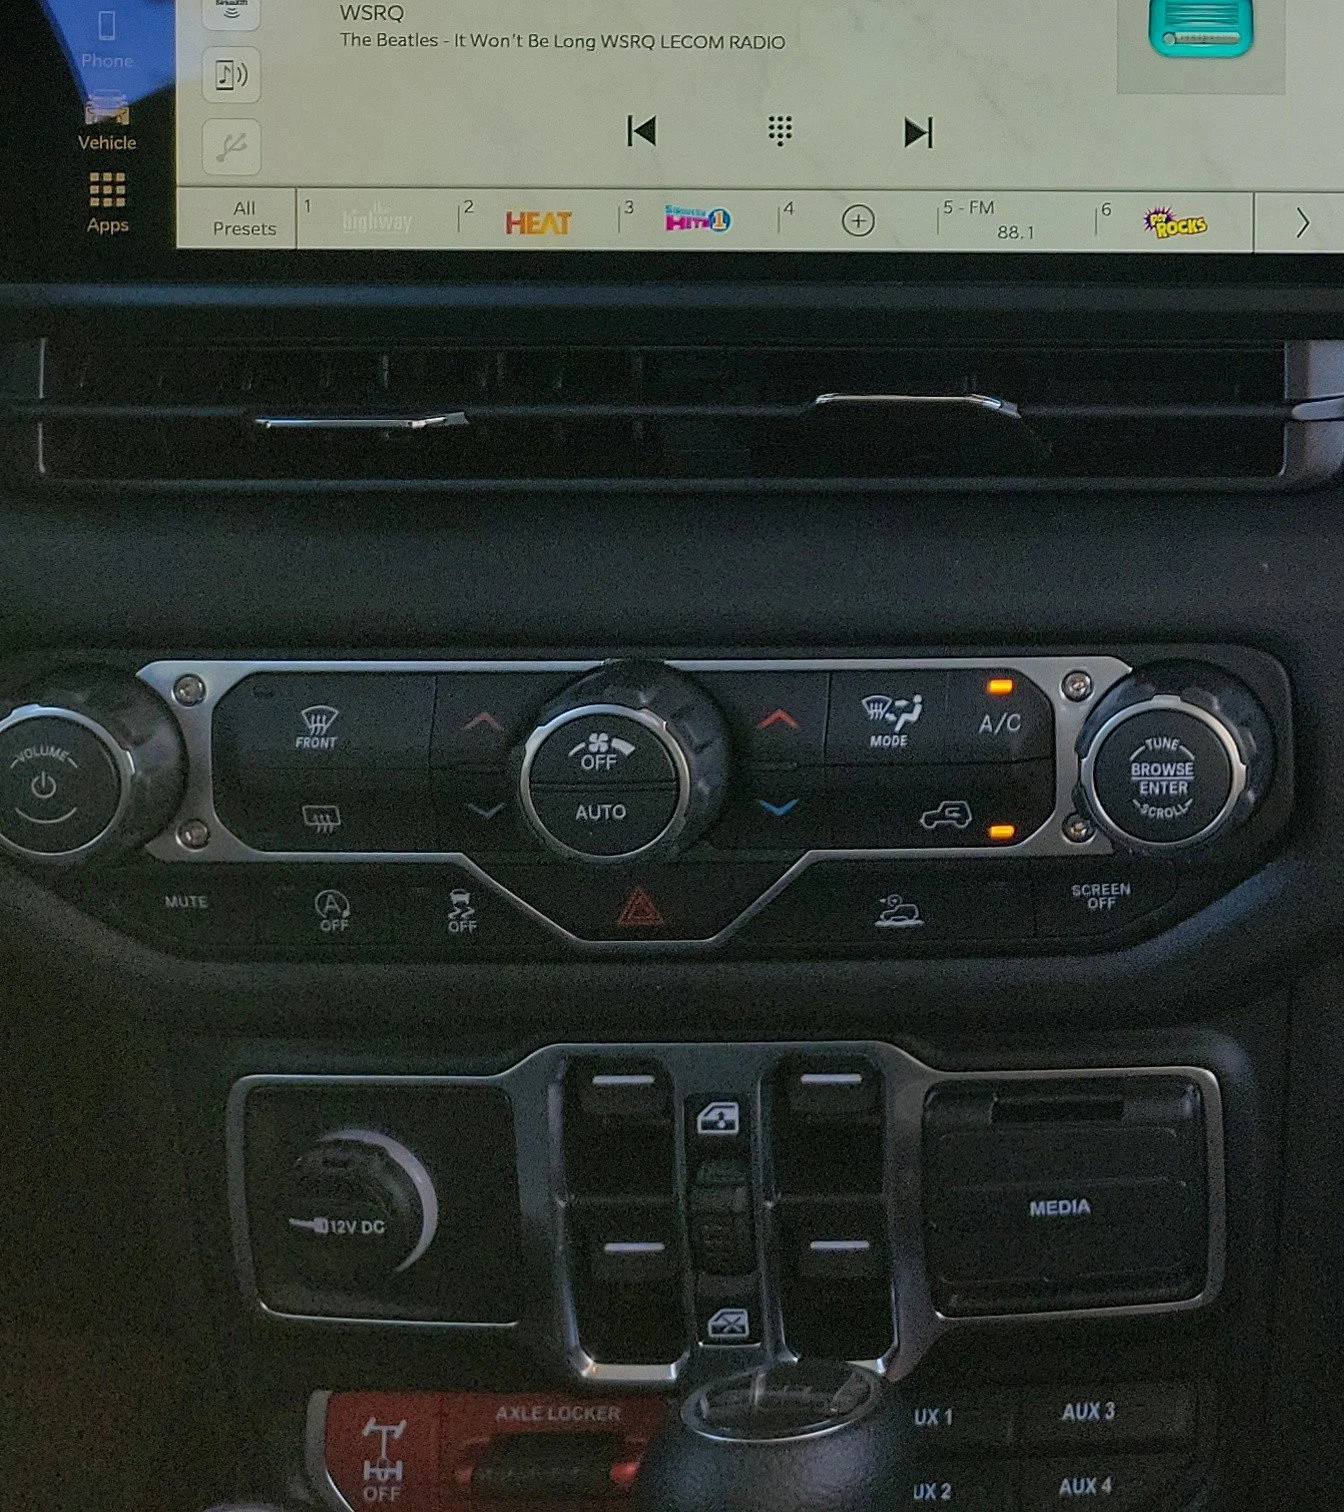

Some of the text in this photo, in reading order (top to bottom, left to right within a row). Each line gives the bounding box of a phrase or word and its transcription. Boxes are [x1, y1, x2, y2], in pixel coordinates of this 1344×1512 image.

[339, 4, 405, 23] WSRQ
[340, 32, 372, 47] The
[377, 33, 439, 48] Beatles
[454, 33, 466, 48] It
[469, 33, 524, 48] Won't
[528, 34, 550, 48] Be
[554, 35, 596, 52] Long
[601, 34, 656, 50] WSRQ
[660, 35, 724, 50] LECOM
[729, 35, 786, 50] RADIO
[82, 53, 133, 69] Phone
[78, 135, 137, 150] Vehicle
[233, 200, 255, 216] All
[304, 198, 311, 213] 1
[464, 199, 475, 214] 2
[624, 200, 634, 214] 3
[783, 201, 794, 215] 4
[943, 200, 953, 214] 5
[969, 200, 995, 215] FM
[1101, 202, 1112, 217] 6
[87, 218, 129, 235] Apps
[213, 221, 277, 236] Presets
[505, 210, 573, 235] HEAT
[1155, 217, 1208, 239] ROCKS
[997, 225, 1034, 240] 88.1
[979, 713, 1021, 735] A/C
[295, 736, 337, 749] FRONT
[870, 735, 907, 748] MODE
[1145, 737, 1180, 751] TUNE
[15, 744, 71, 762] VOLUME
[580, 754, 617, 771] OFF
[1131, 762, 1194, 776] BROWSE
[1140, 781, 1188, 795] ENTER
[575, 804, 626, 821] AUTO
[1140, 803, 1188, 819] SCROLL
[1071, 883, 1131, 897] SCREEN
[165, 895, 209, 909] MUTE
[1087, 897, 1116, 910] OFF
[320, 919, 349, 932] OFF
[448, 920, 478, 934] OFF
[1029, 1197, 1091, 1216] MEDIA
[330, 1220, 385, 1235] 12V DC
[495, 1406, 622, 1421] AXLE LOCKER
[914, 1408, 953, 1426] UX 1
[1062, 1401, 1116, 1421] AUX 3
[913, 1482, 952, 1500] UX 2
[1058, 1476, 1113, 1496] AUX 4
[363, 1487, 401, 1502] OFF
